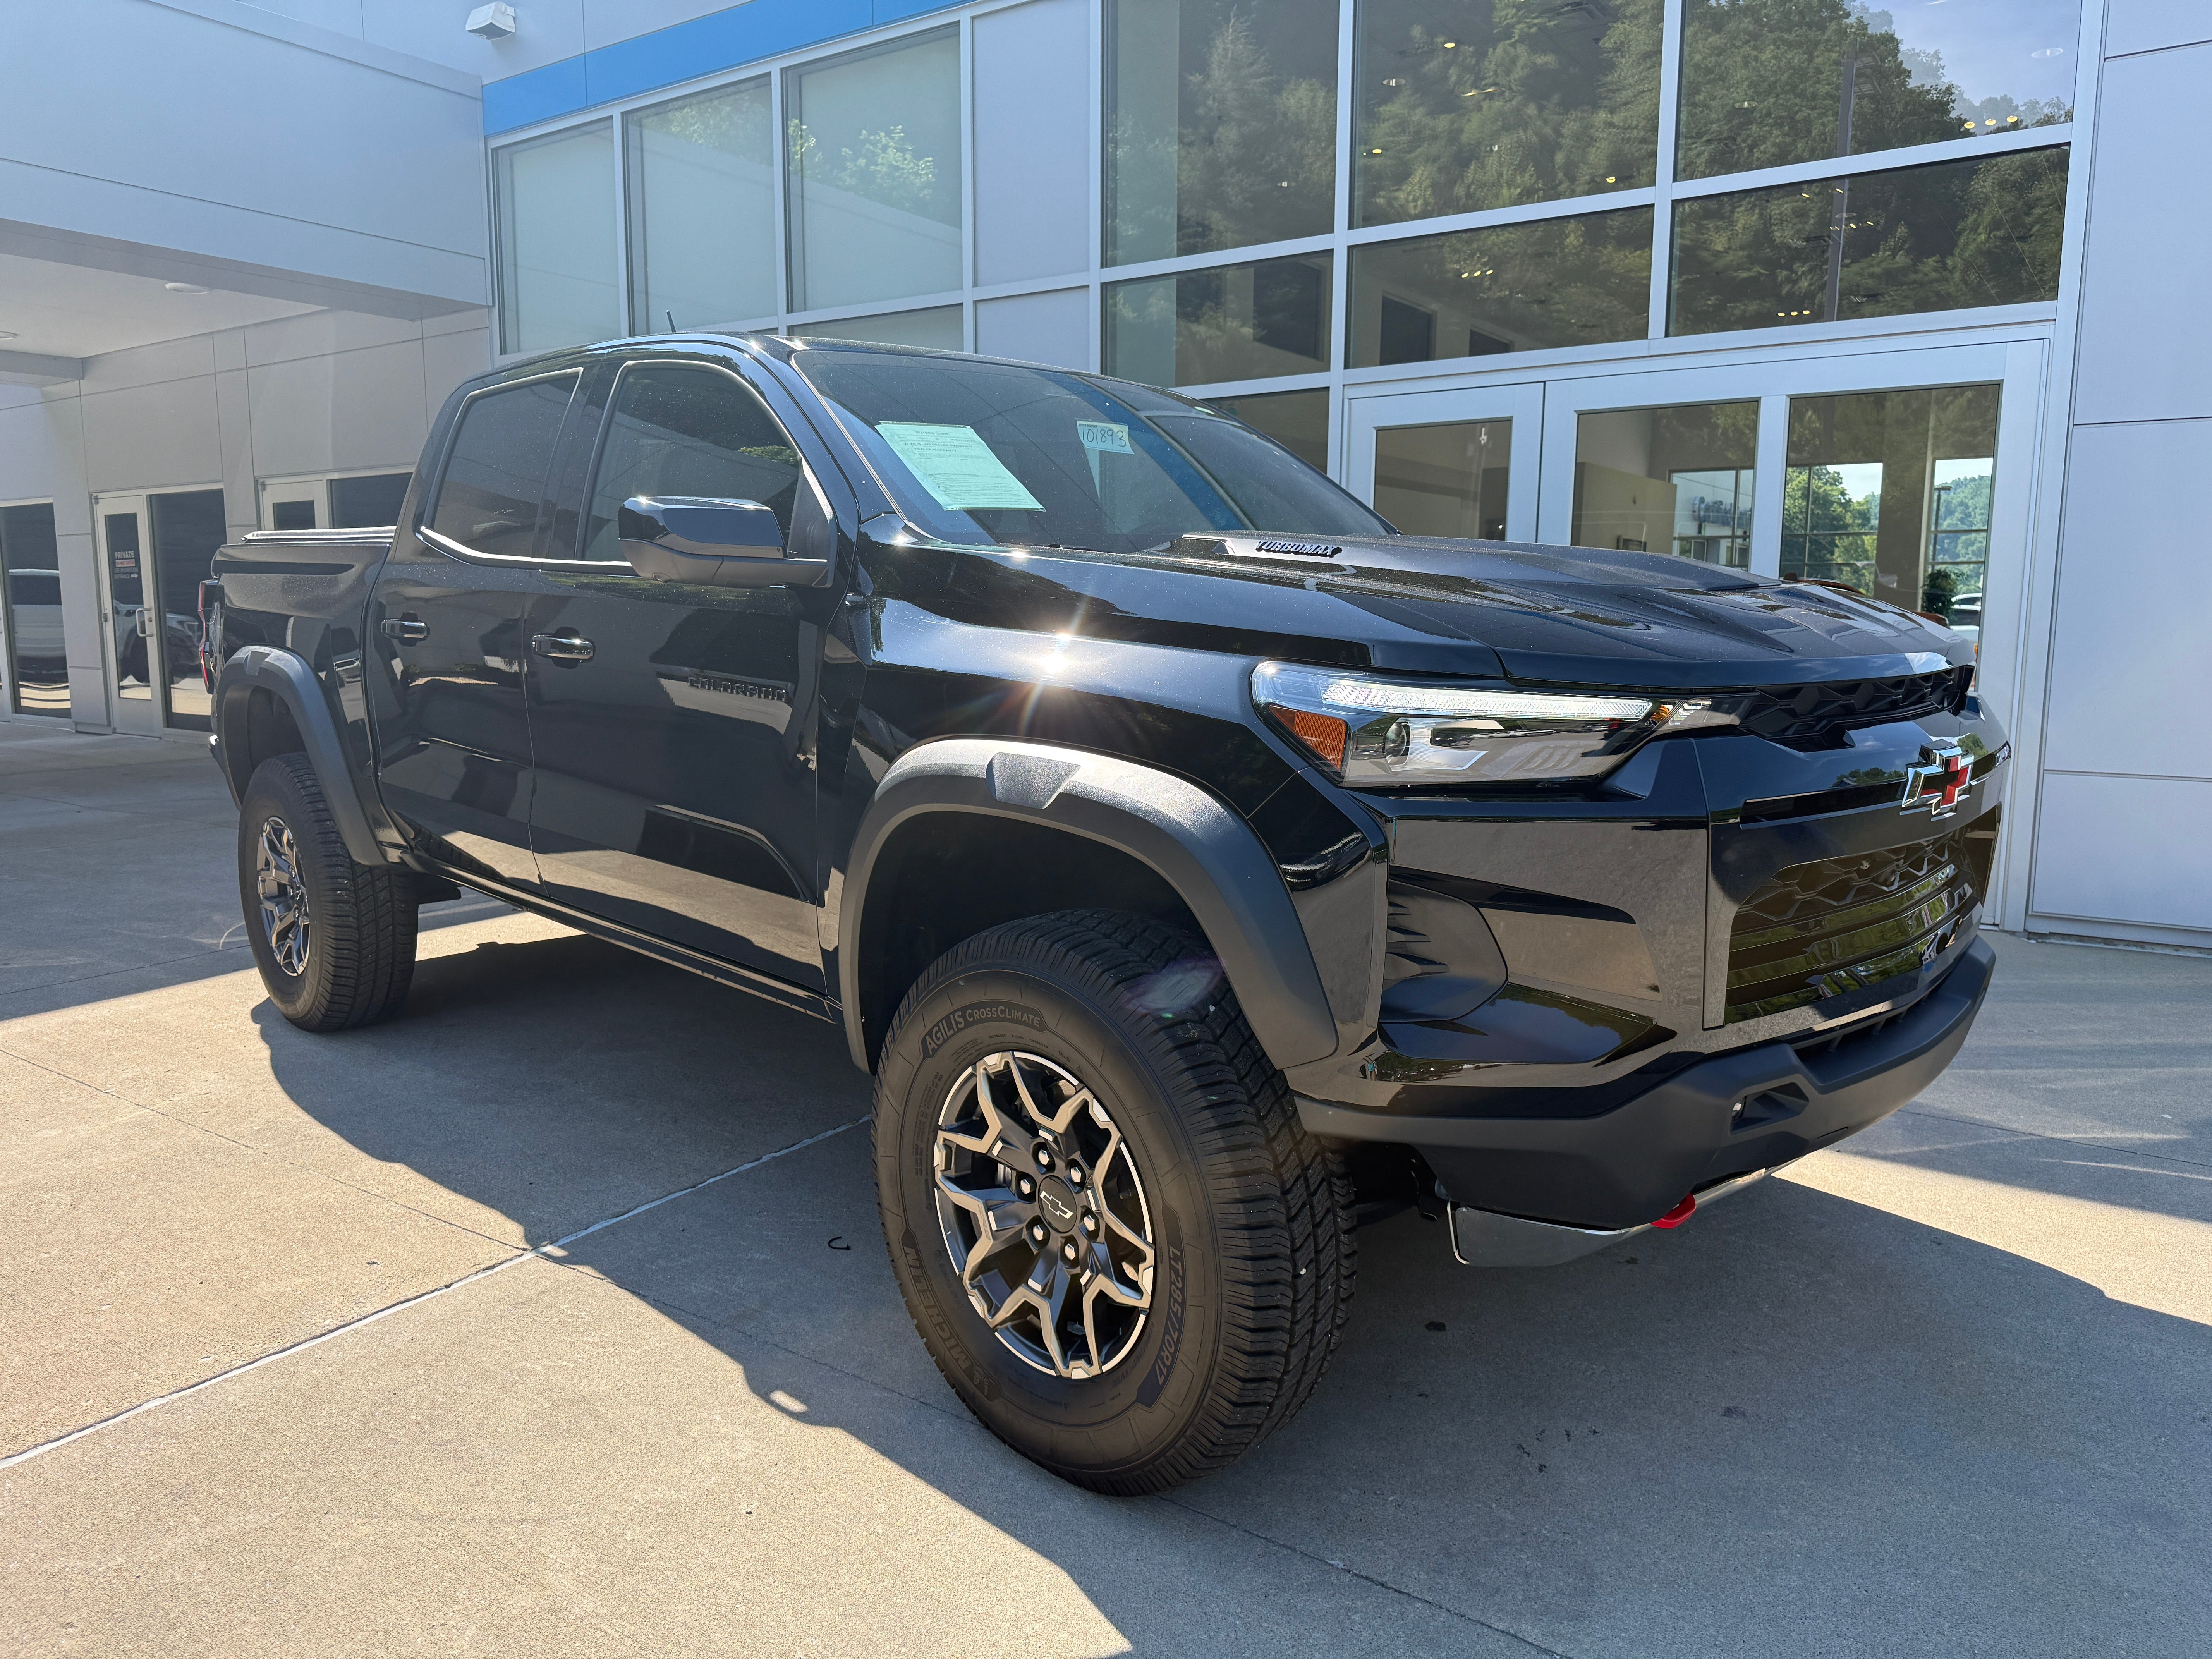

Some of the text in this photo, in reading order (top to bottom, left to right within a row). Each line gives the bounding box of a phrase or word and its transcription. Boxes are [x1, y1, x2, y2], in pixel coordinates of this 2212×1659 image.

[1083, 428, 1127, 447] 101893
[115, 551, 134, 559] PRIVATE
[1255, 540, 1339, 557] TURBOMAX
[926, 1011, 965, 1056] AGILIS
[903, 1245, 974, 1370] MICHELIN
[1155, 1244, 1183, 1387] LT285/70R17
